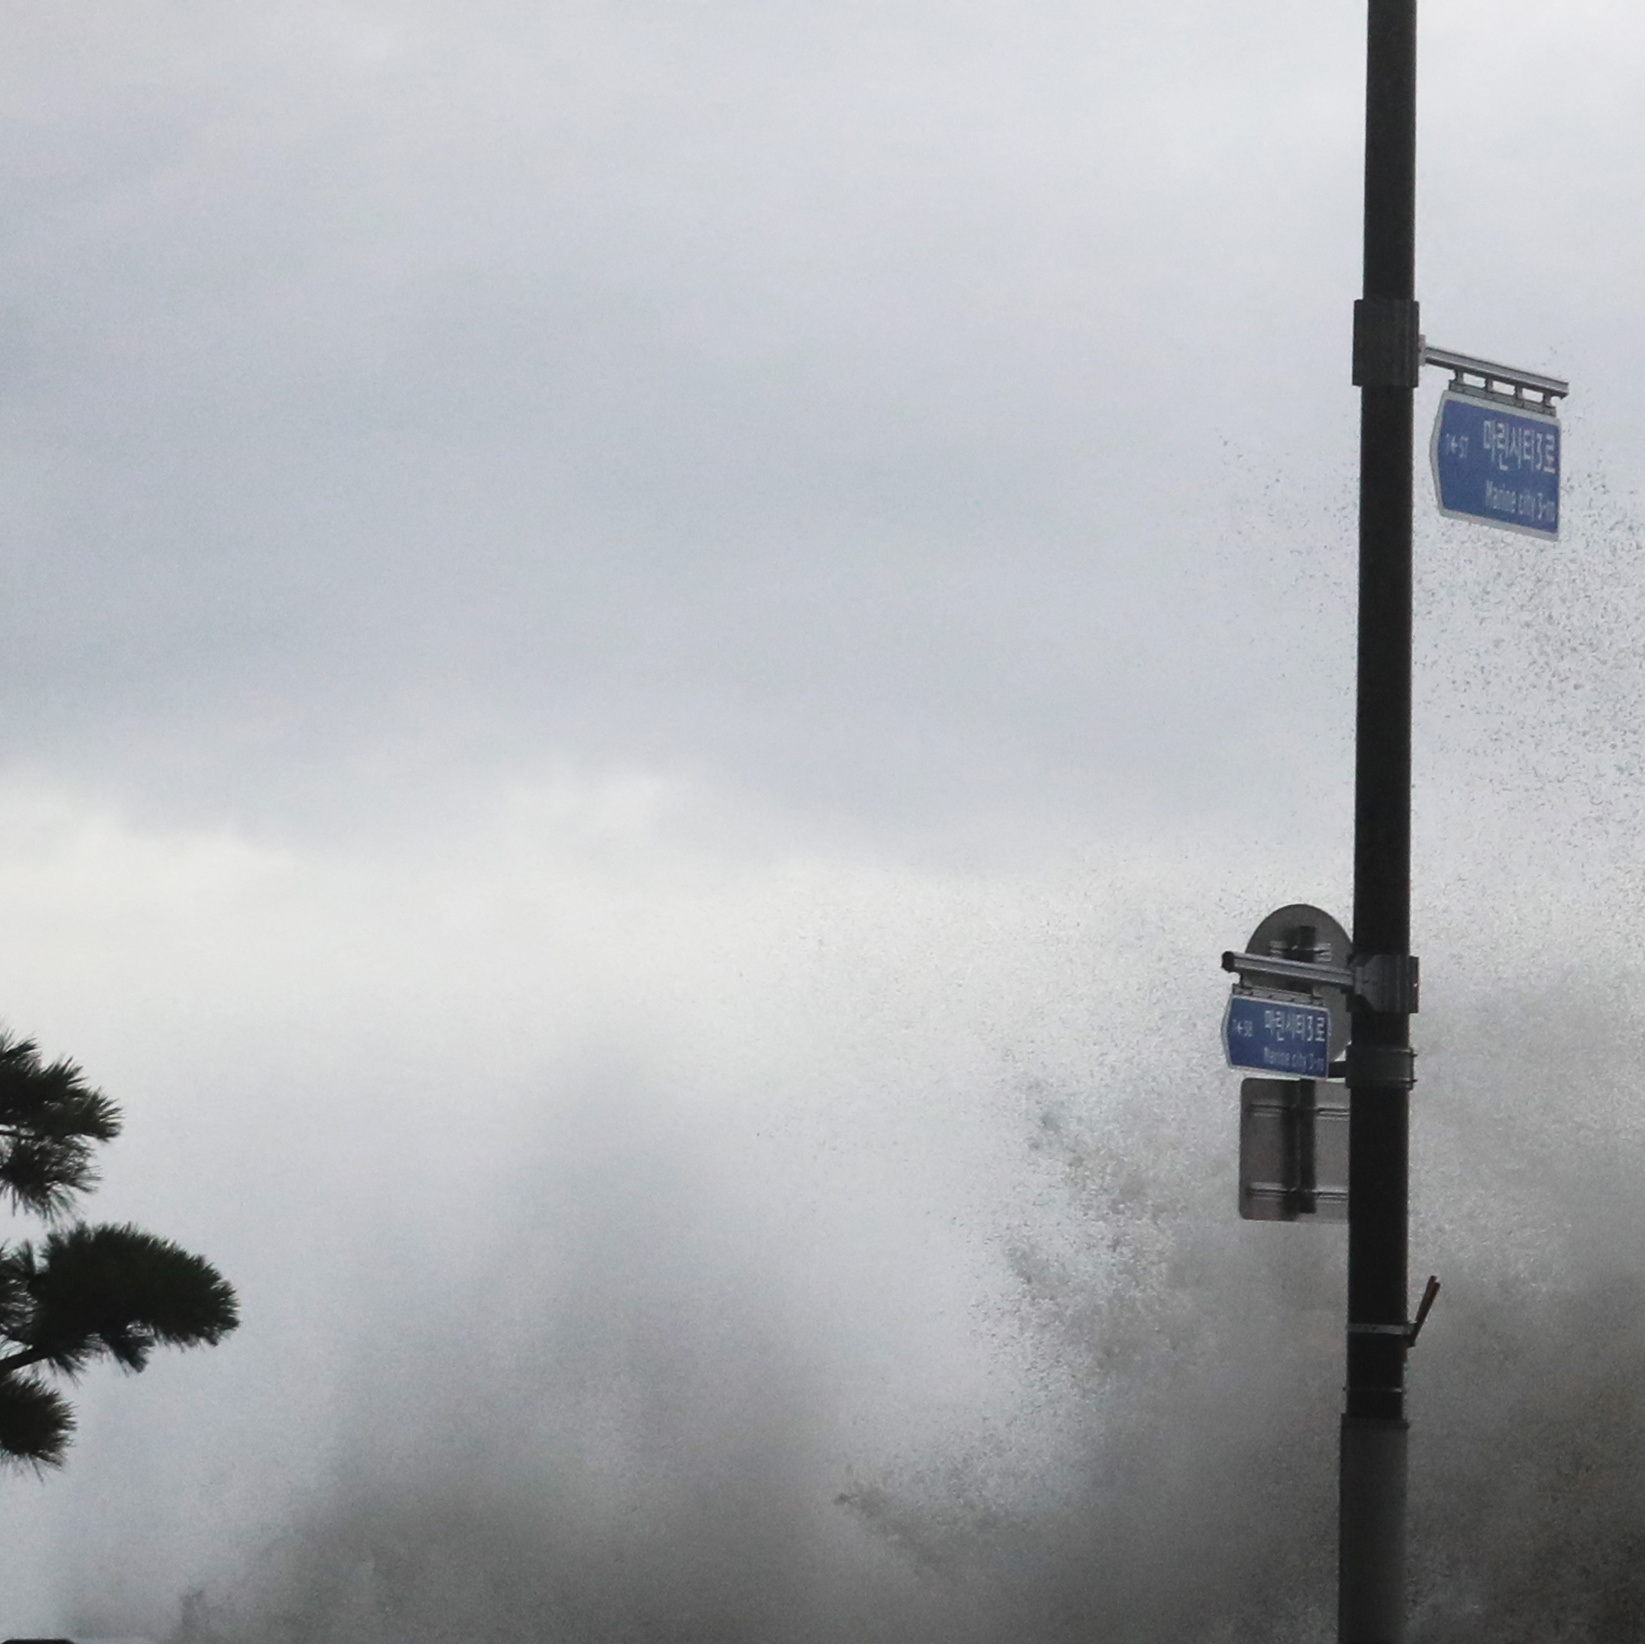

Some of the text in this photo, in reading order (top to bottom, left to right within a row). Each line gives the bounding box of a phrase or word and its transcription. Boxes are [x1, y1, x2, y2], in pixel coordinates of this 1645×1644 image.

[1484, 420, 1555, 474] 마린시티3로
[1485, 480, 1517, 514] Marine
[1264, 1010, 1325, 1041] 마린시티3로
